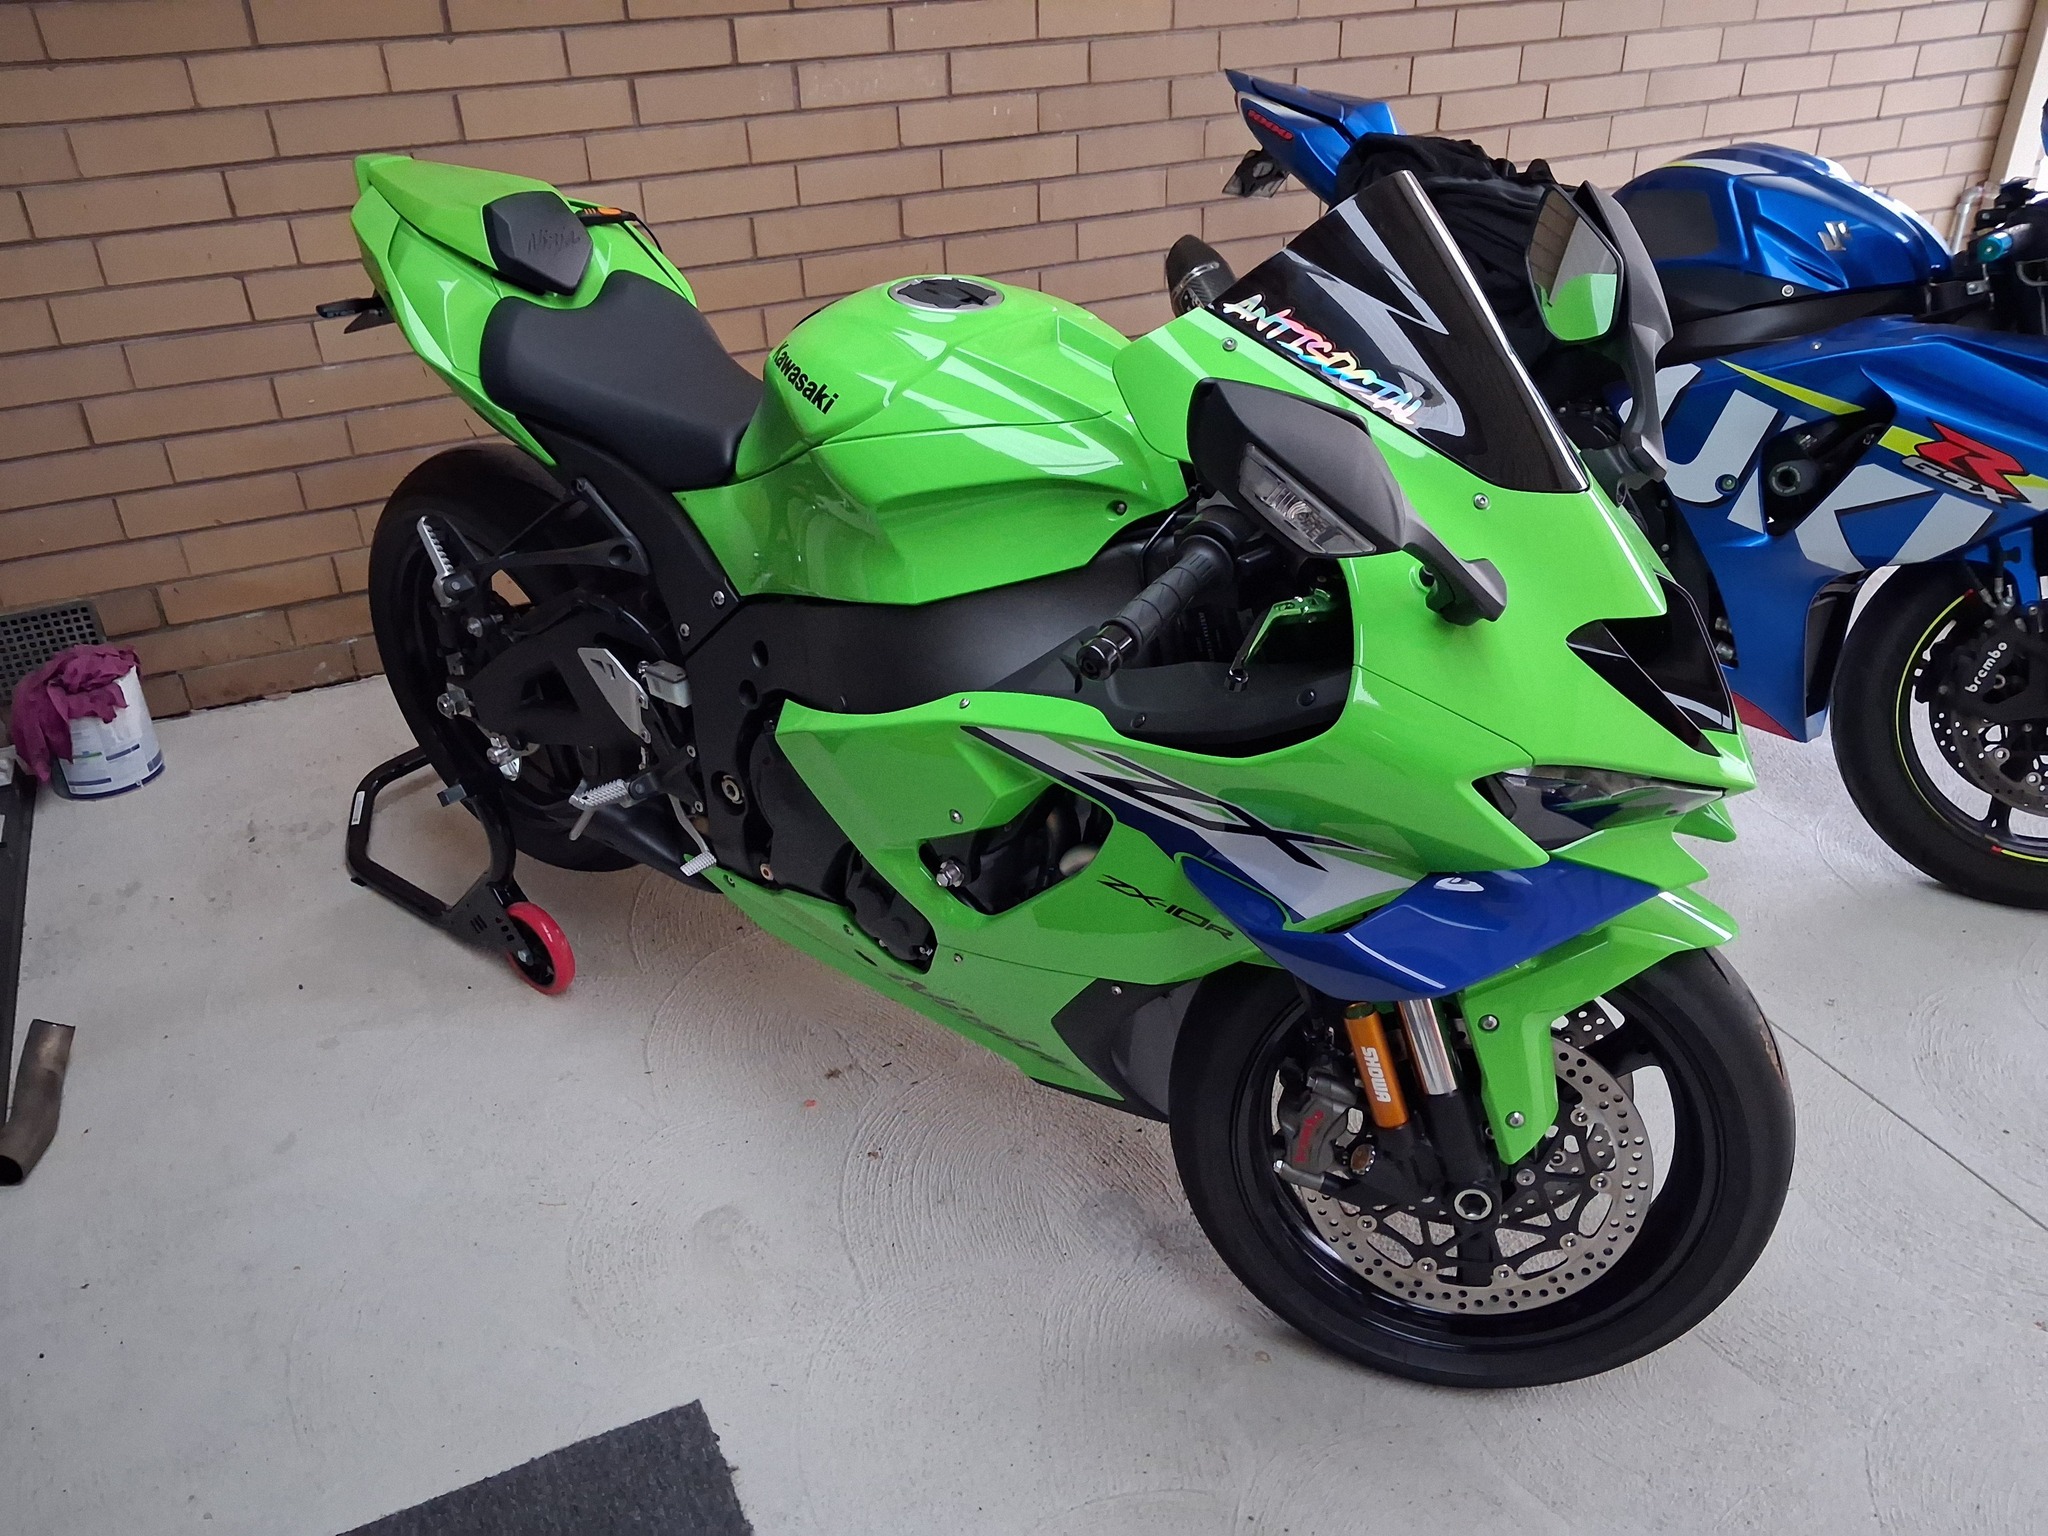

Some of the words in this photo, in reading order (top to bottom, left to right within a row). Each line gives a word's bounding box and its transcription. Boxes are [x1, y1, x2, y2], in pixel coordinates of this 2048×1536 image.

[772, 340, 840, 415] Kawasaki
[1222, 293, 1423, 426] ANTISOCIAL
[1964, 642, 2008, 693] brembo
[1096, 873, 1234, 941] ZX-10R
[1361, 1046, 1393, 1103] SHOWA
